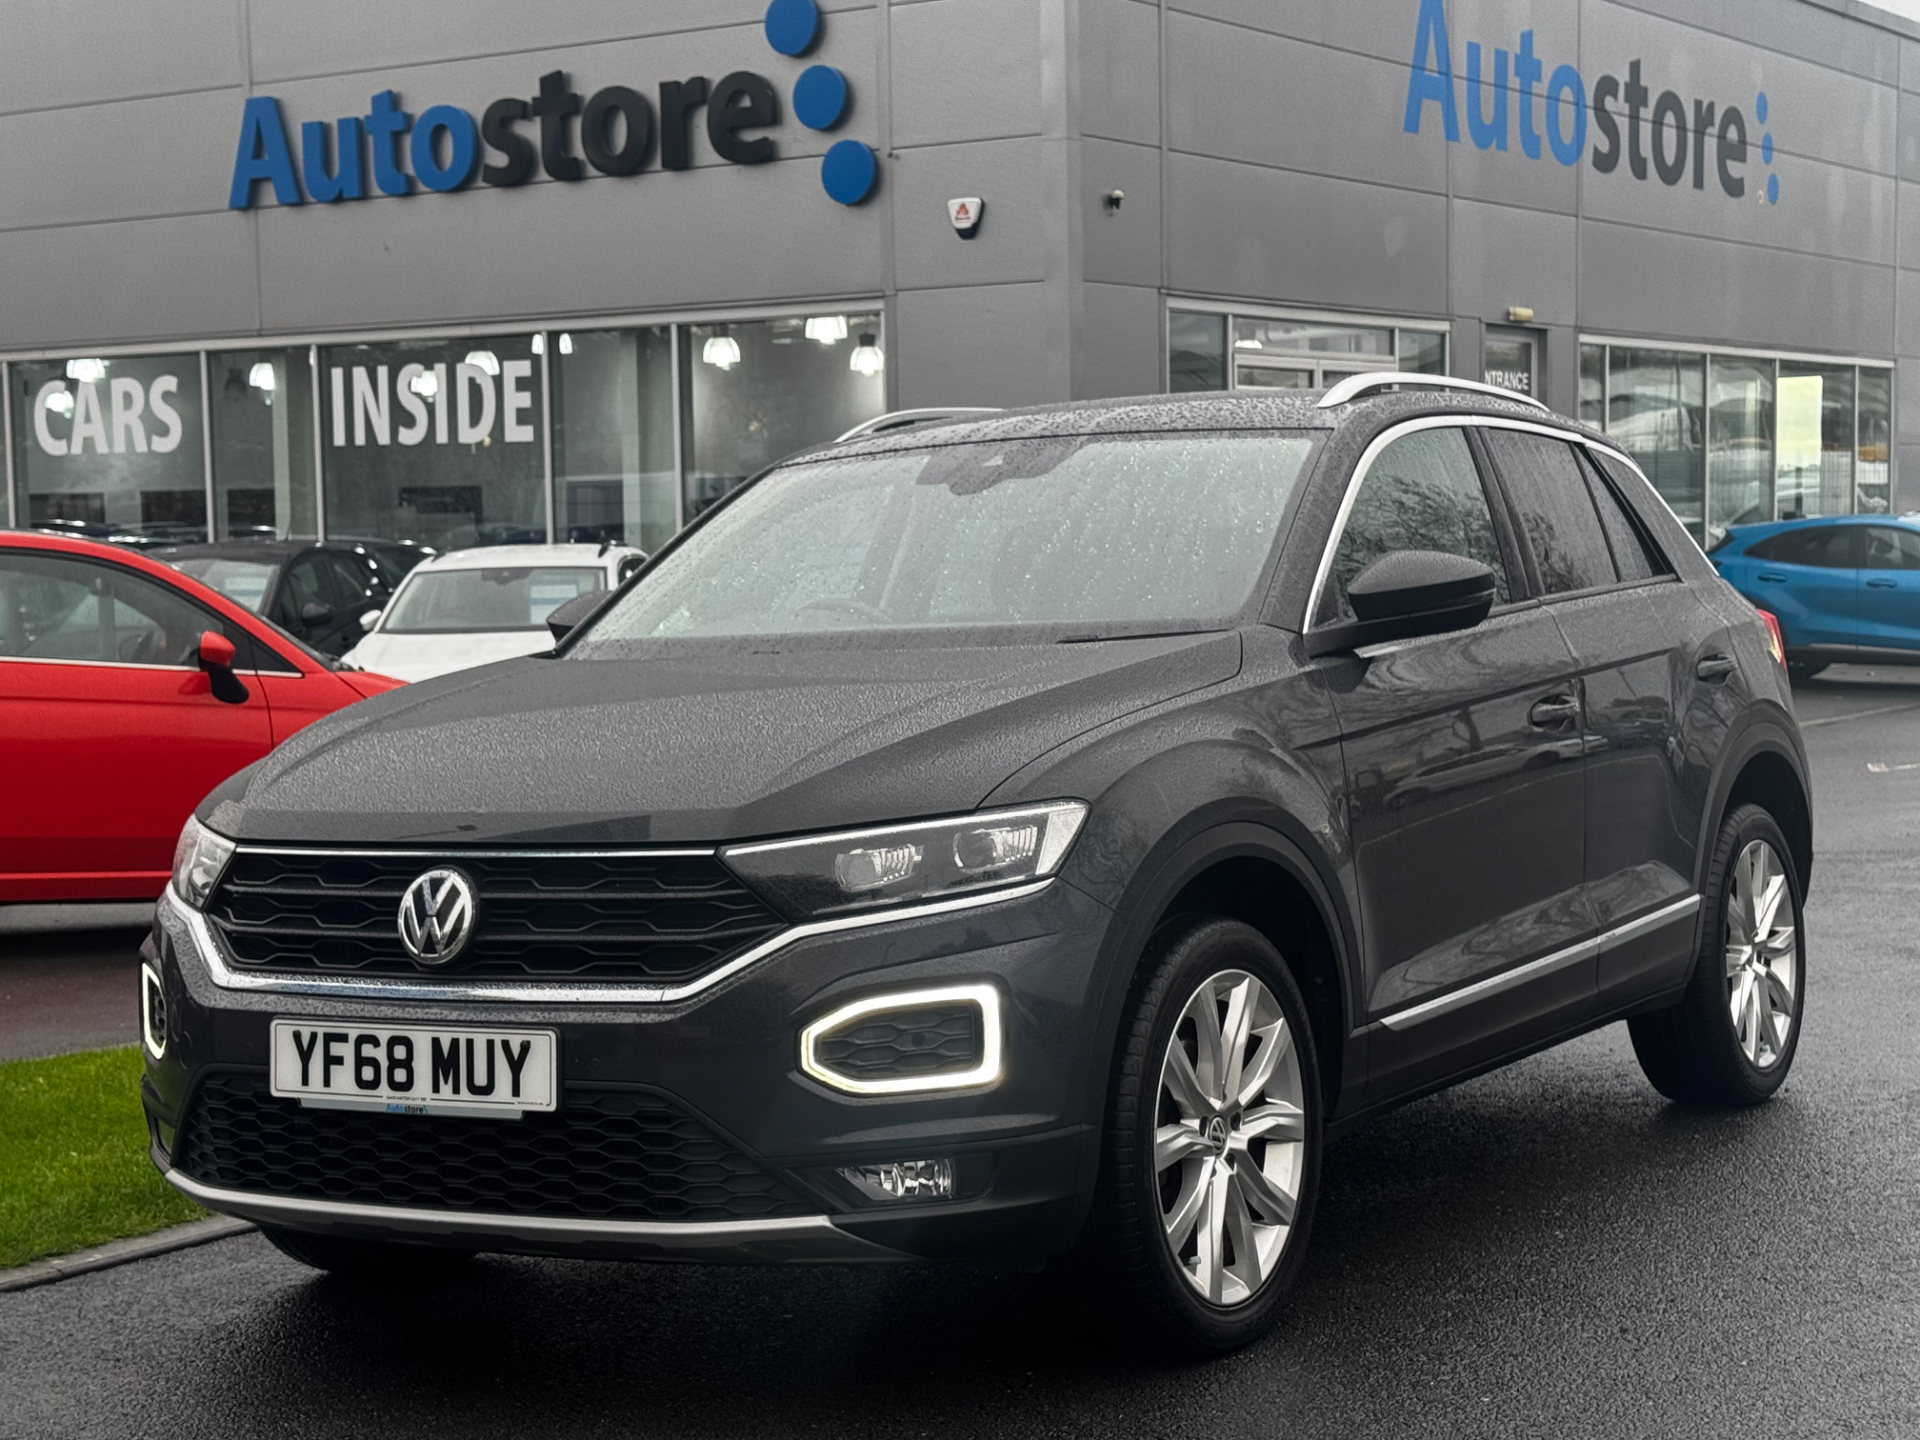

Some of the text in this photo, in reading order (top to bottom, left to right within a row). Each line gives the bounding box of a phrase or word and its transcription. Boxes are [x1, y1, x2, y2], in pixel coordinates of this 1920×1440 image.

[229, 70, 778, 210] Autostore
[1403, 0, 1747, 198] Autostore
[34, 360, 534, 456] CARS INSIDE
[1484, 370, 1530, 391] NTRANCE
[292, 1029, 531, 1098] YF68 MUY
[386, 1103, 424, 1115] Autostore
